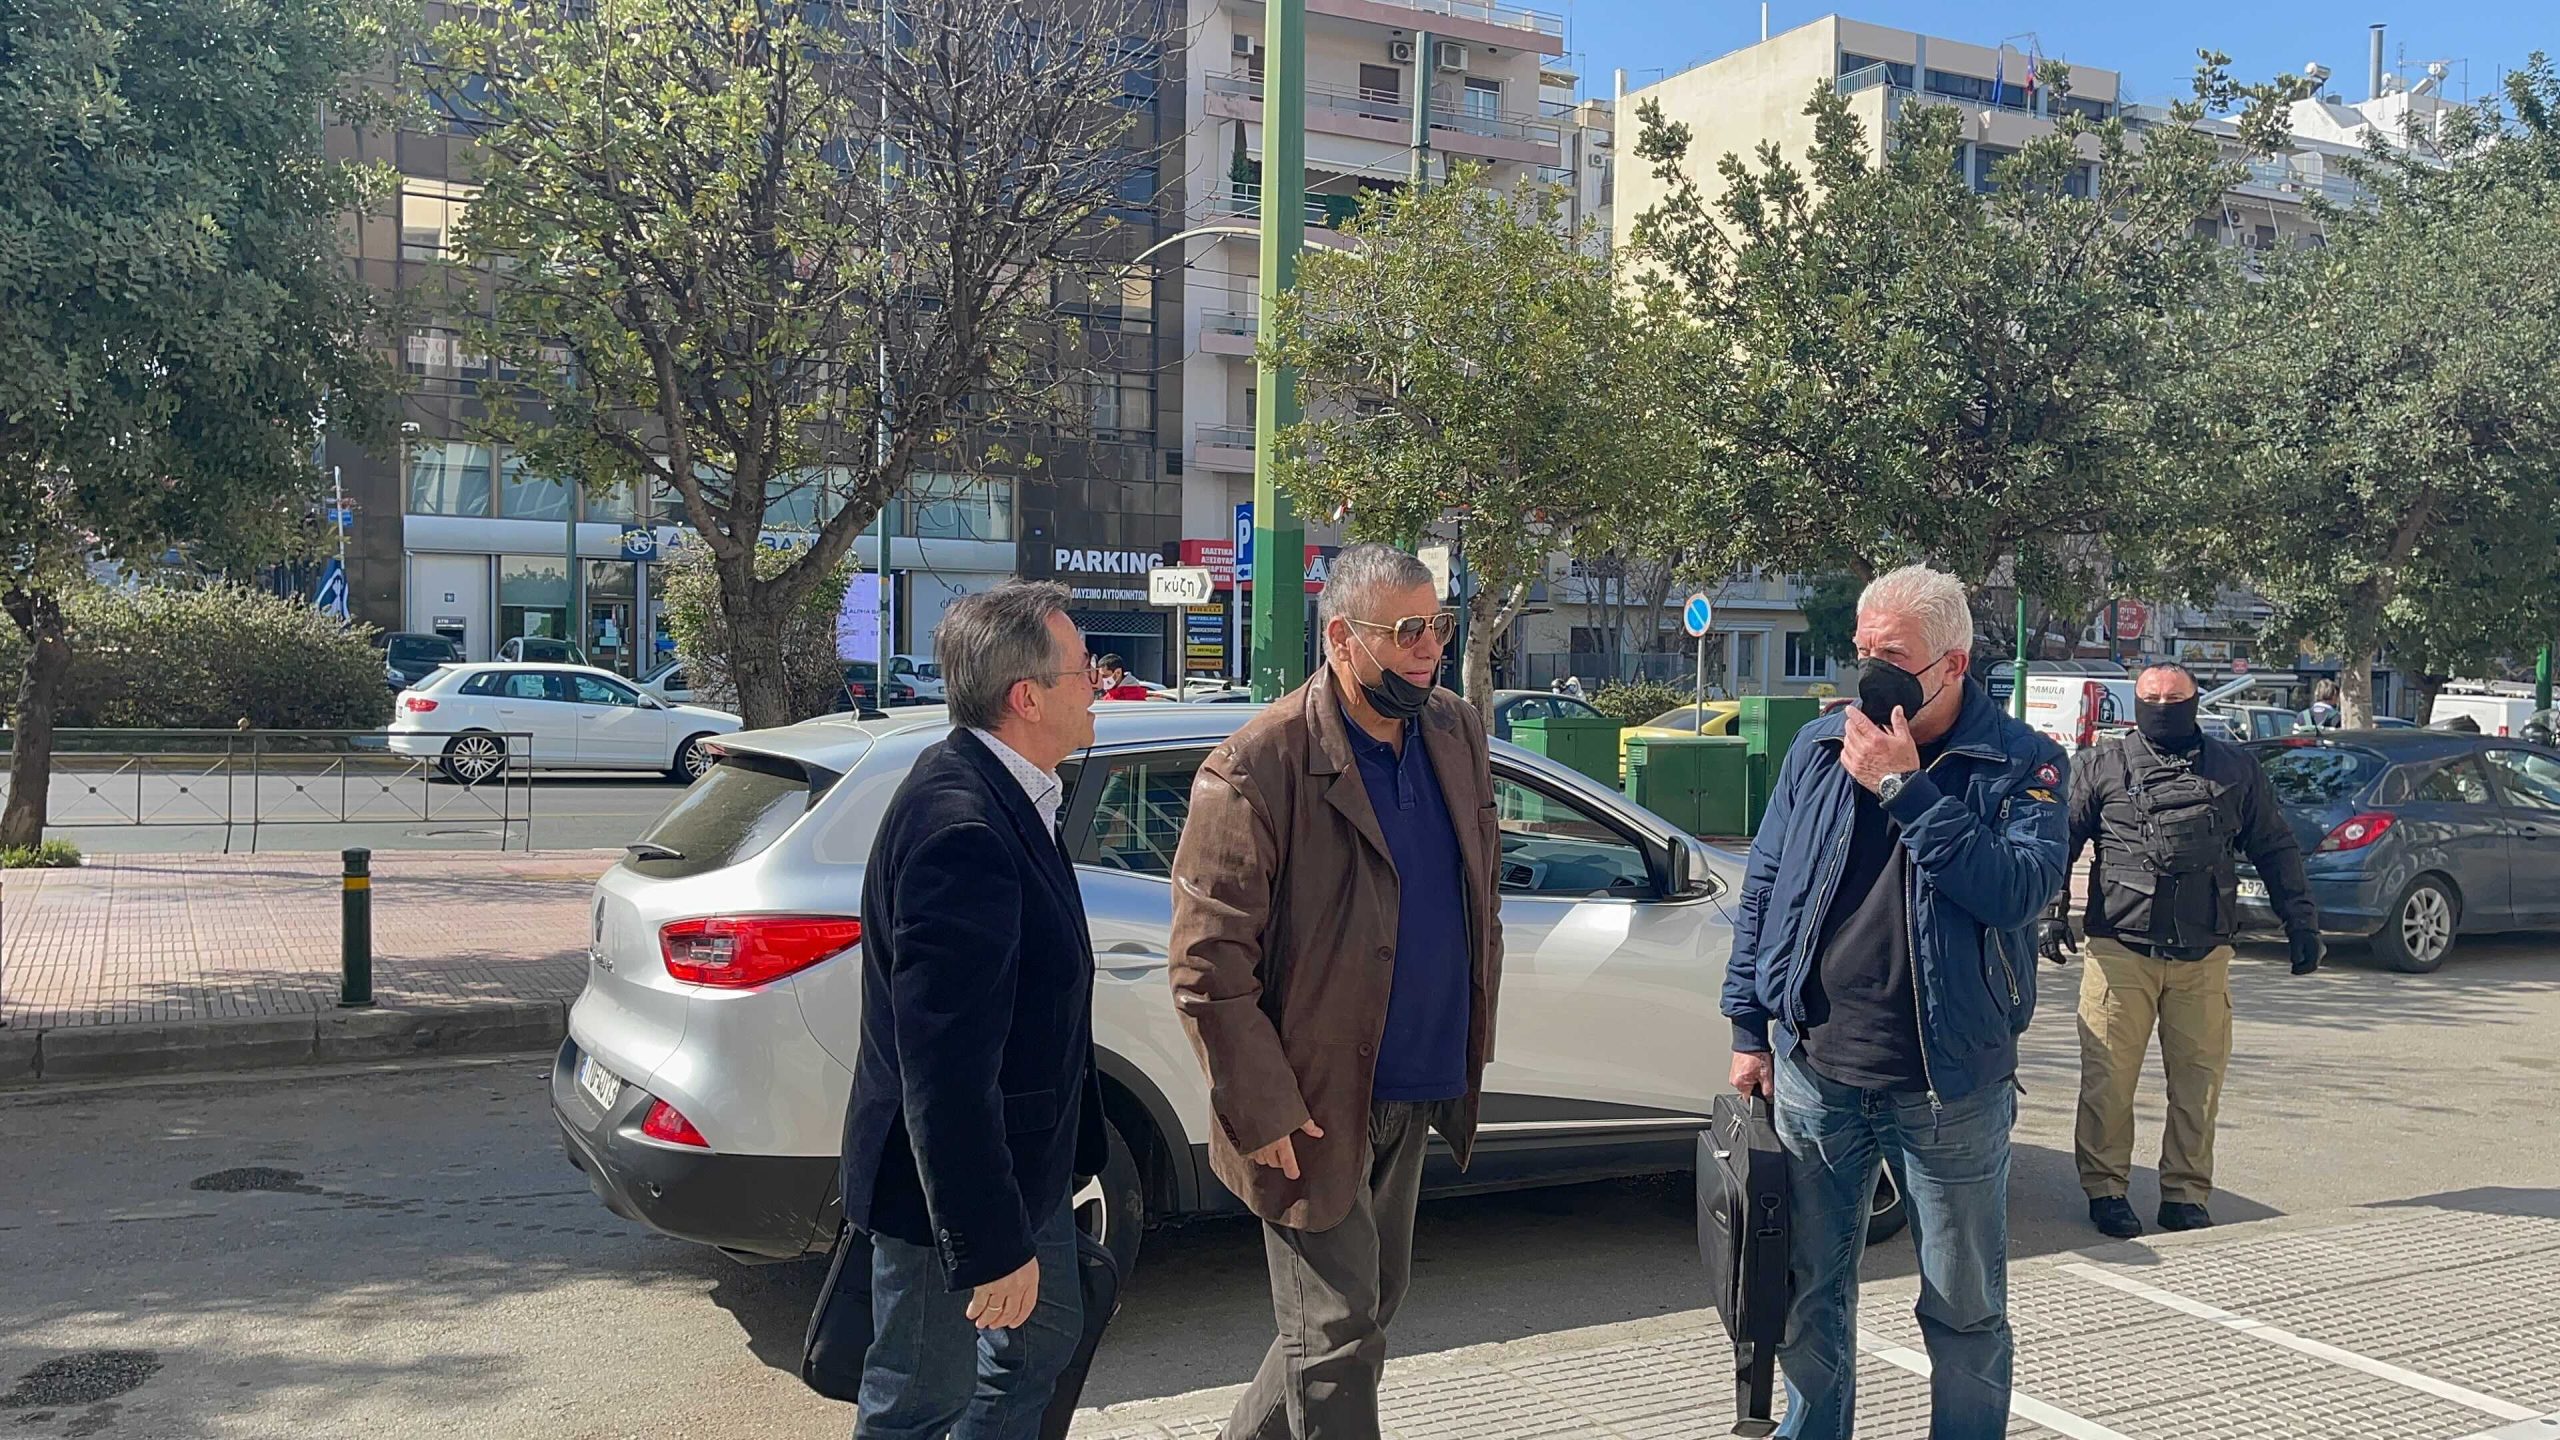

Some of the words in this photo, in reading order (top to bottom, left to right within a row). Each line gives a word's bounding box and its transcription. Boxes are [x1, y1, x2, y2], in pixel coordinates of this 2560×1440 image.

[1055, 548, 1164, 574] PARKING
[1156, 576, 1195, 597] Γκύζη
[2026, 685, 2066, 696] ORMULA
